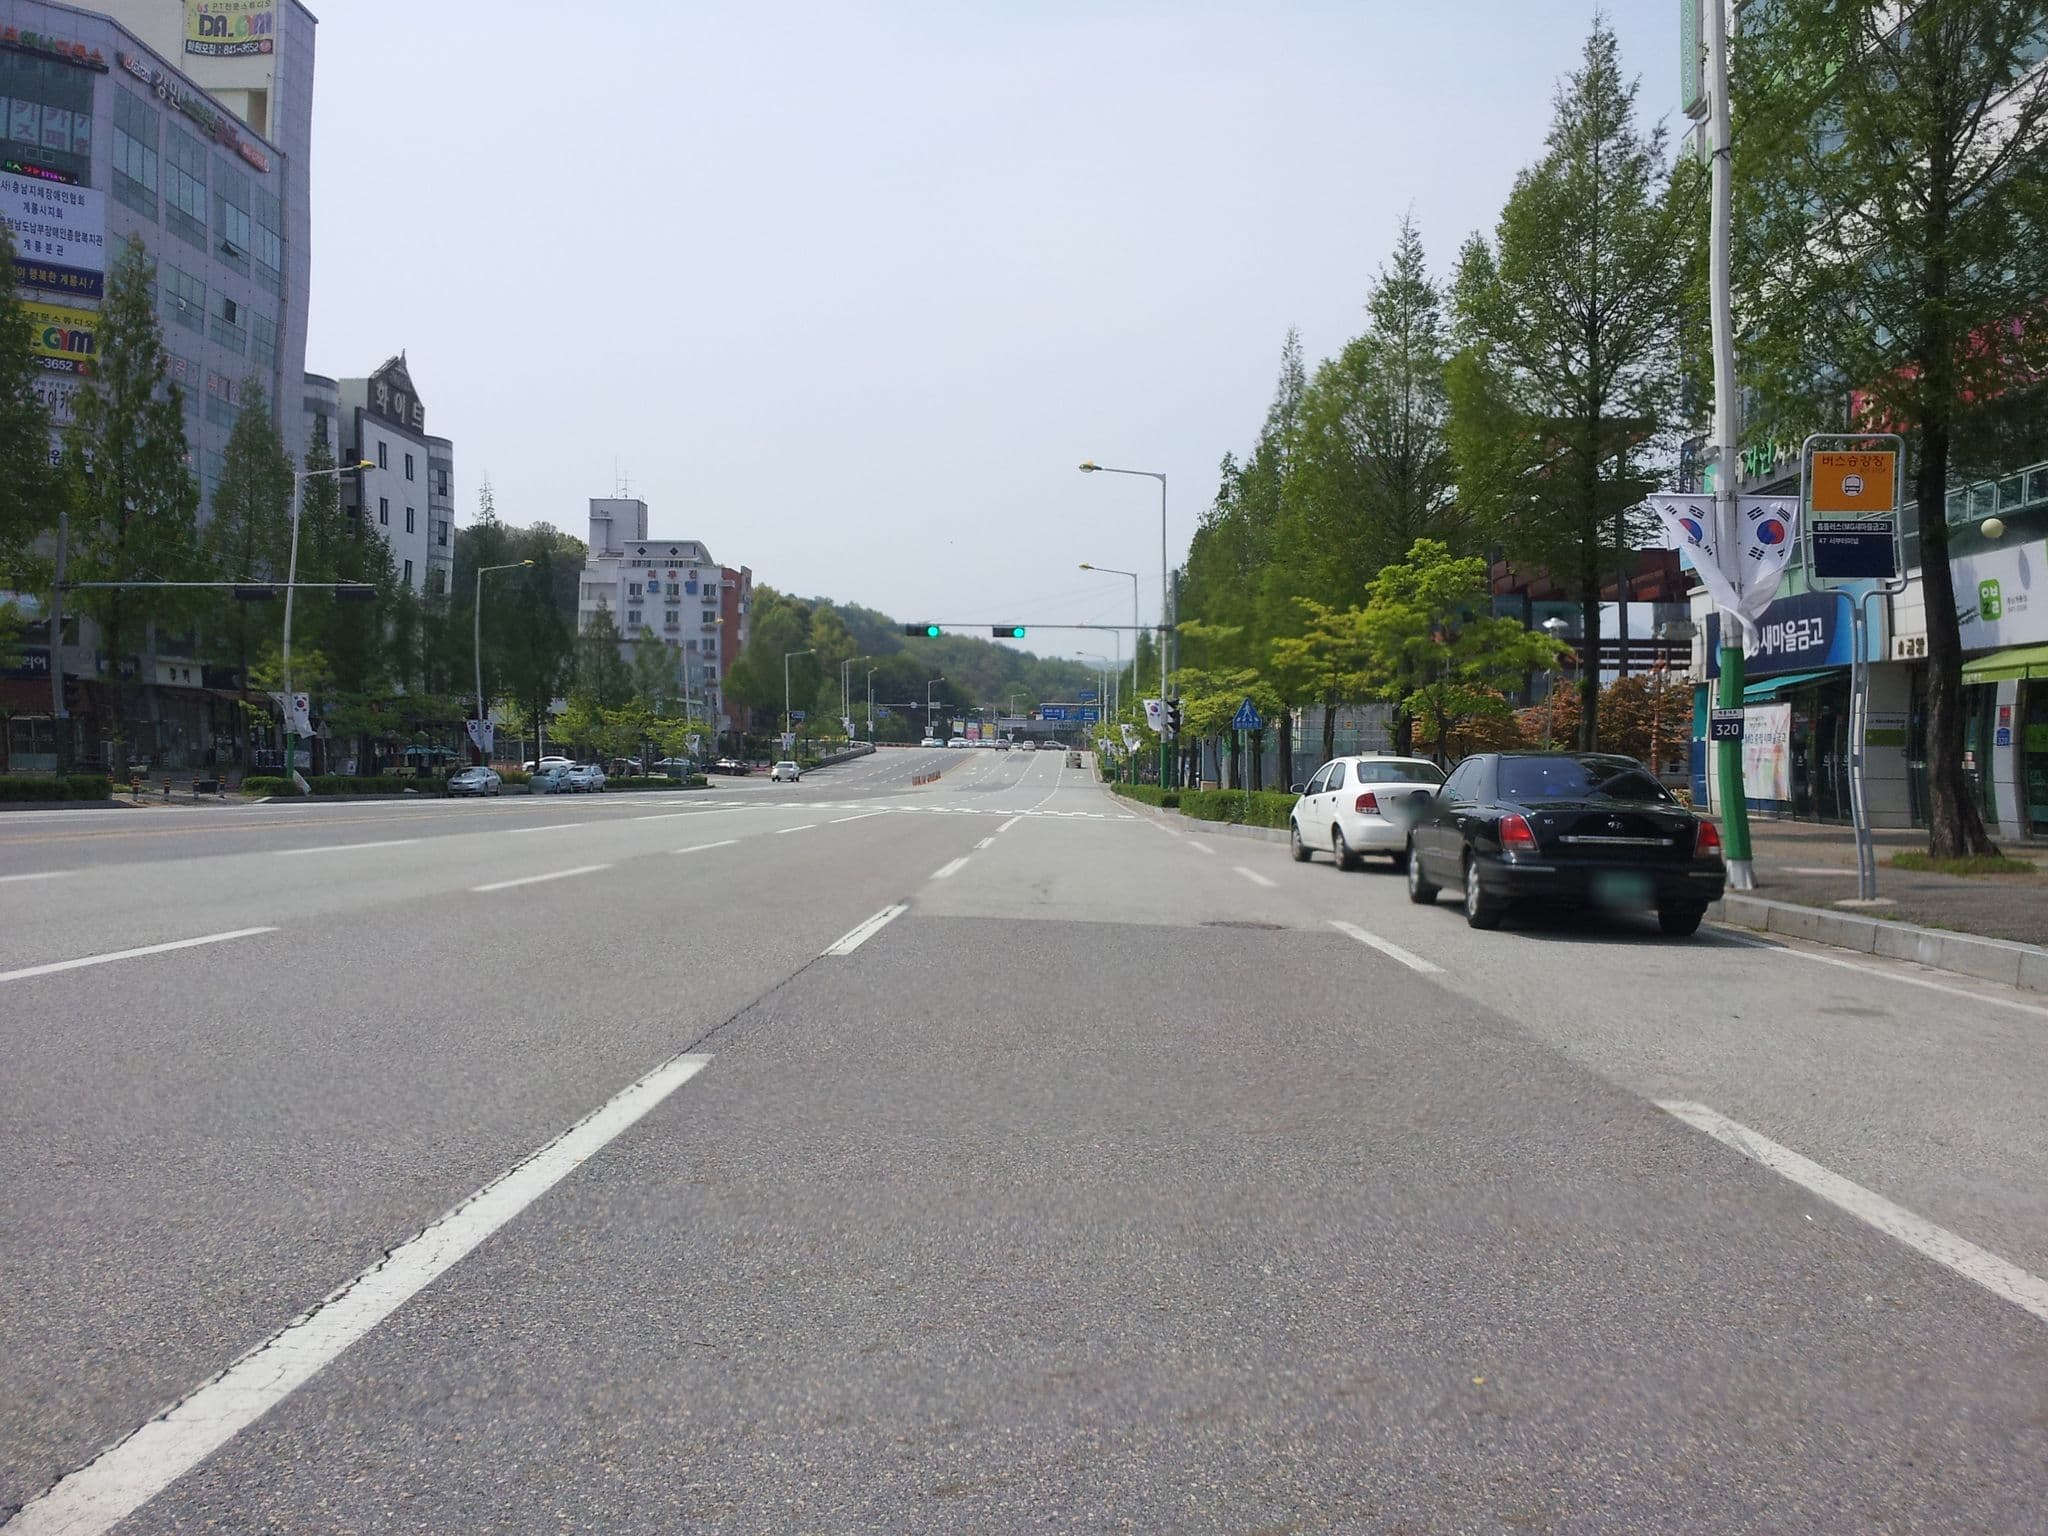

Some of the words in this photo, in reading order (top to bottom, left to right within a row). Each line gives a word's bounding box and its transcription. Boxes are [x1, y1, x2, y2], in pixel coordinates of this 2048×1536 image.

[1822, 455, 1884, 468] 버스승강장
[1760, 617, 1824, 655] 새마을금고
[1715, 723, 1739, 736] 320
